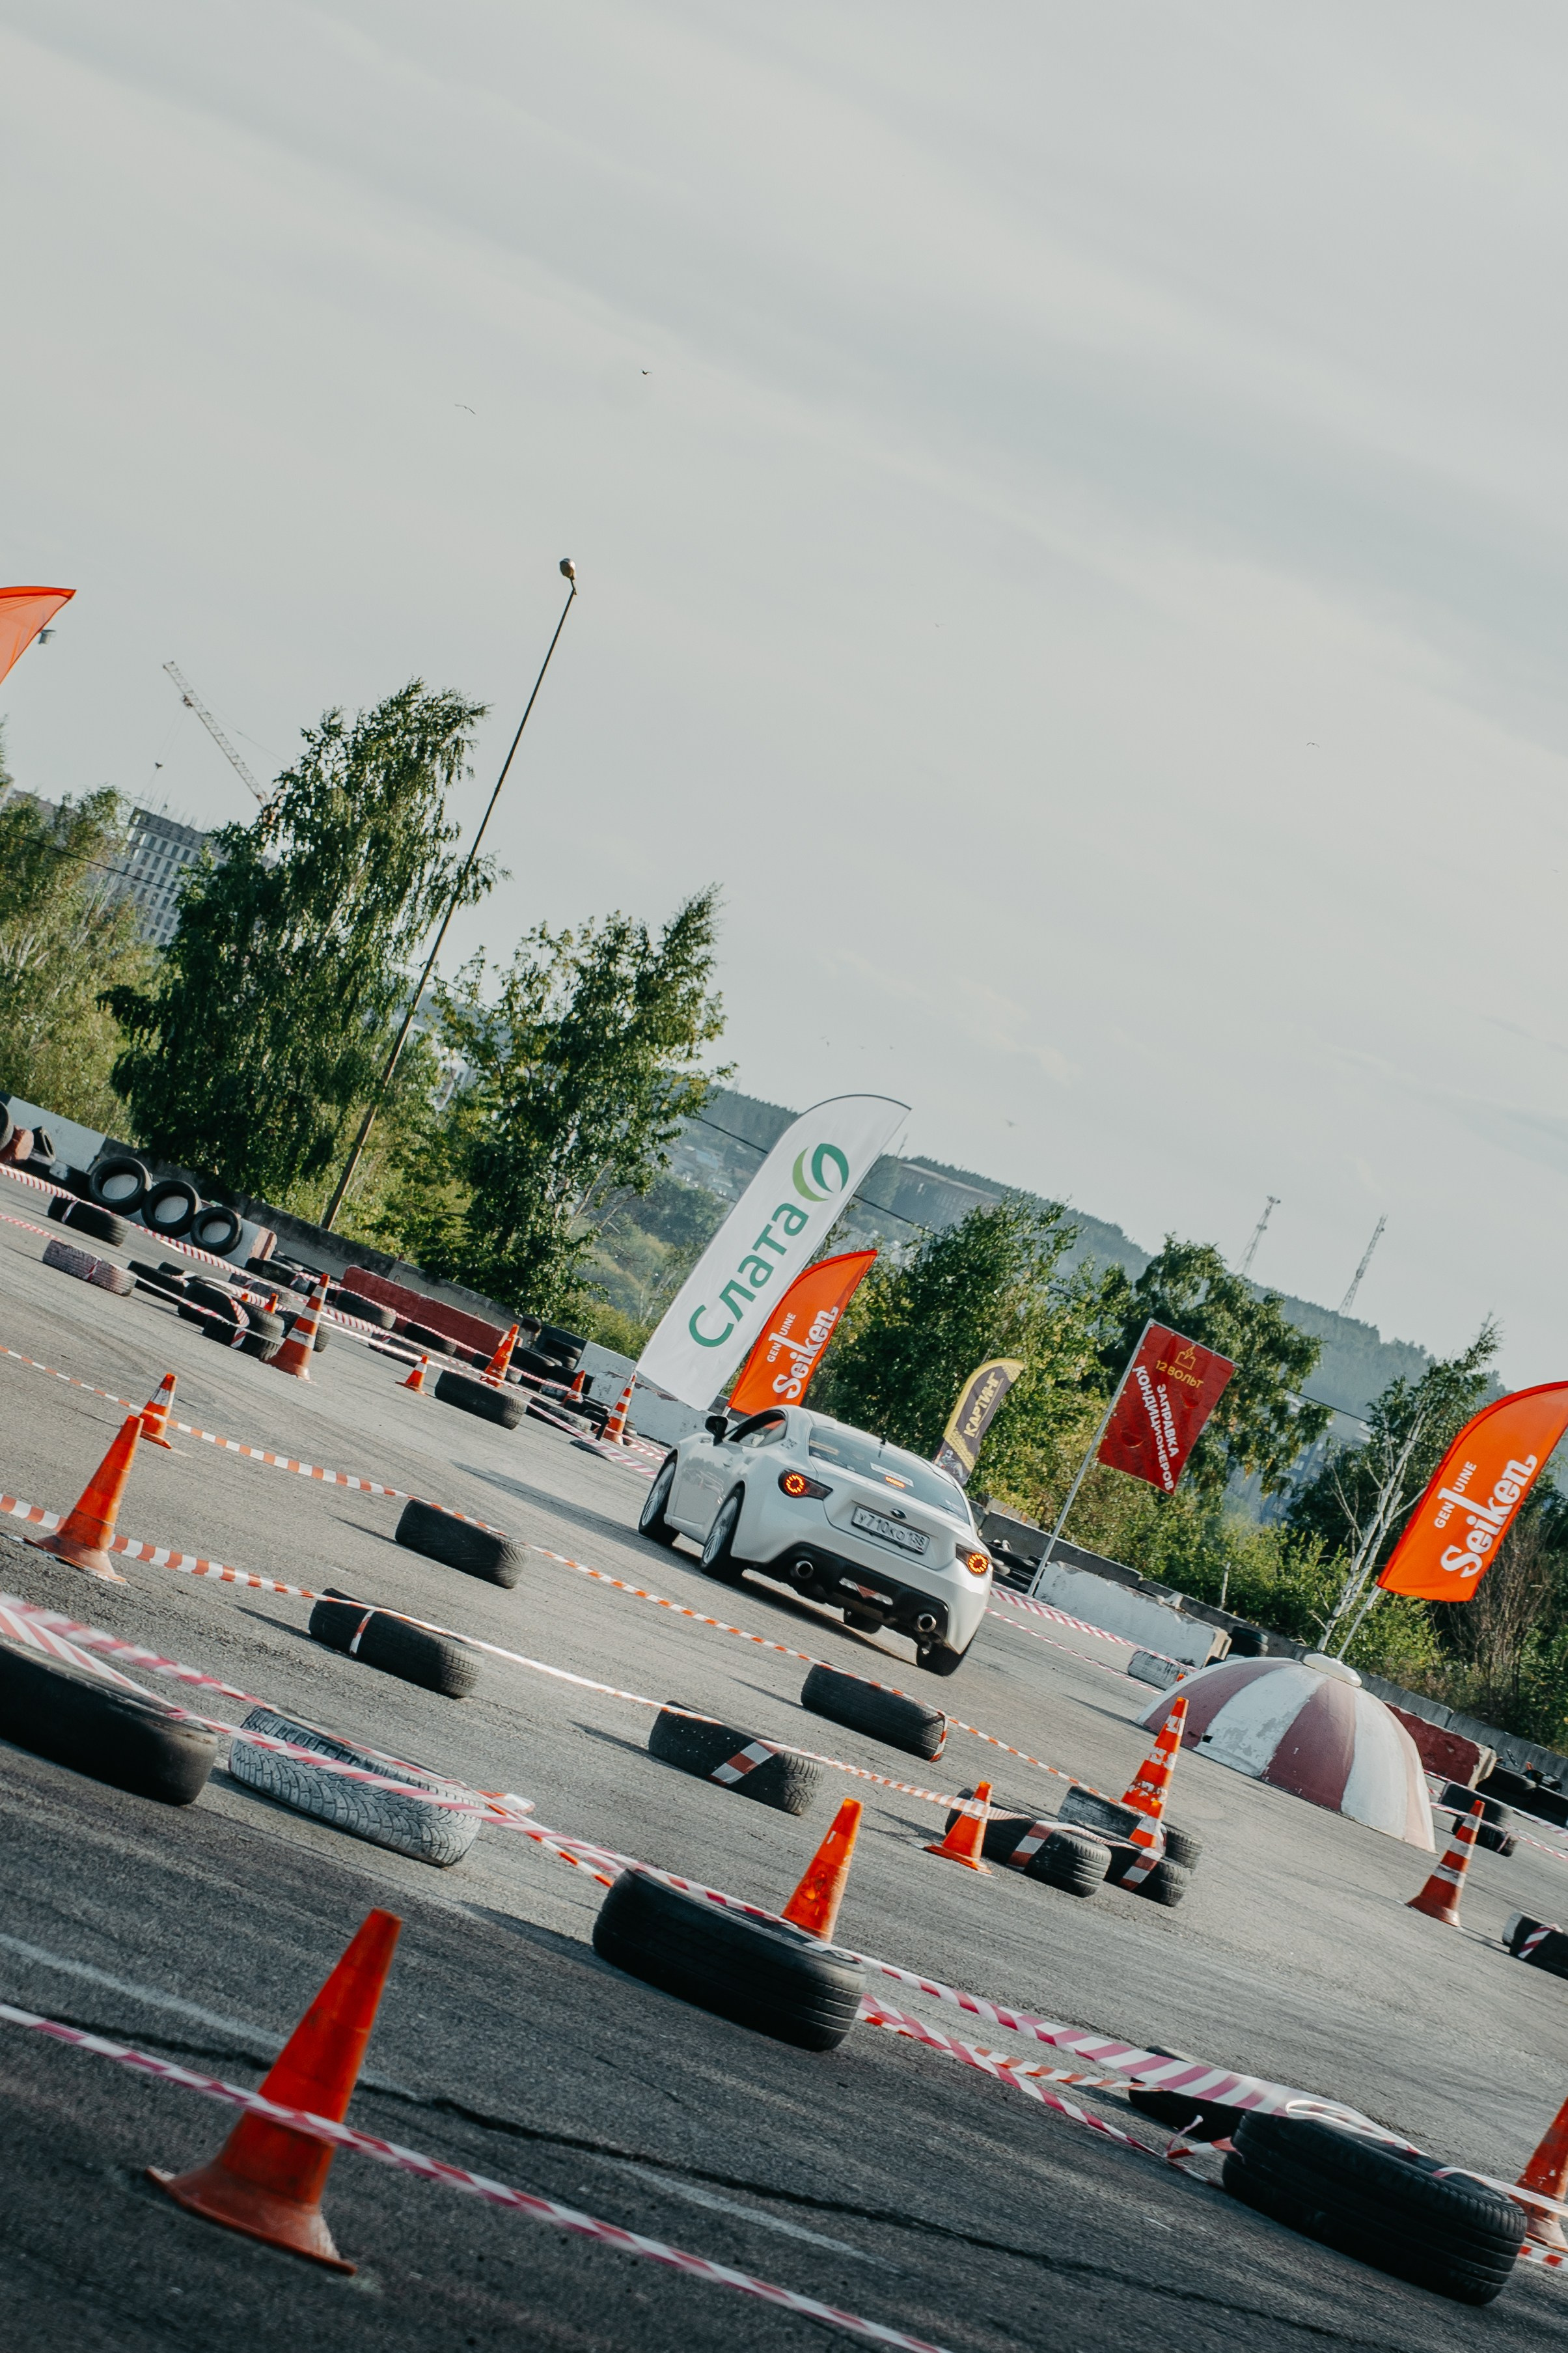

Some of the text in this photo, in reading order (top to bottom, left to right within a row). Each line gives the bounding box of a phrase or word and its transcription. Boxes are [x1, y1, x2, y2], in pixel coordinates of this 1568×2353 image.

[689, 1203, 810, 1348] Слата
[769, 1306, 839, 1399] Seiken
[1155, 1359, 1204, 1389] 12 ВОЛЬТ
[963, 1371, 1002, 1438] КАРТИНГ
[1133, 1365, 1174, 1490] КОНДИЦИОНЕРОВ
[1156, 1383, 1179, 1458] ЗАПРАВКА
[1436, 1454, 1538, 1578] Seiken
